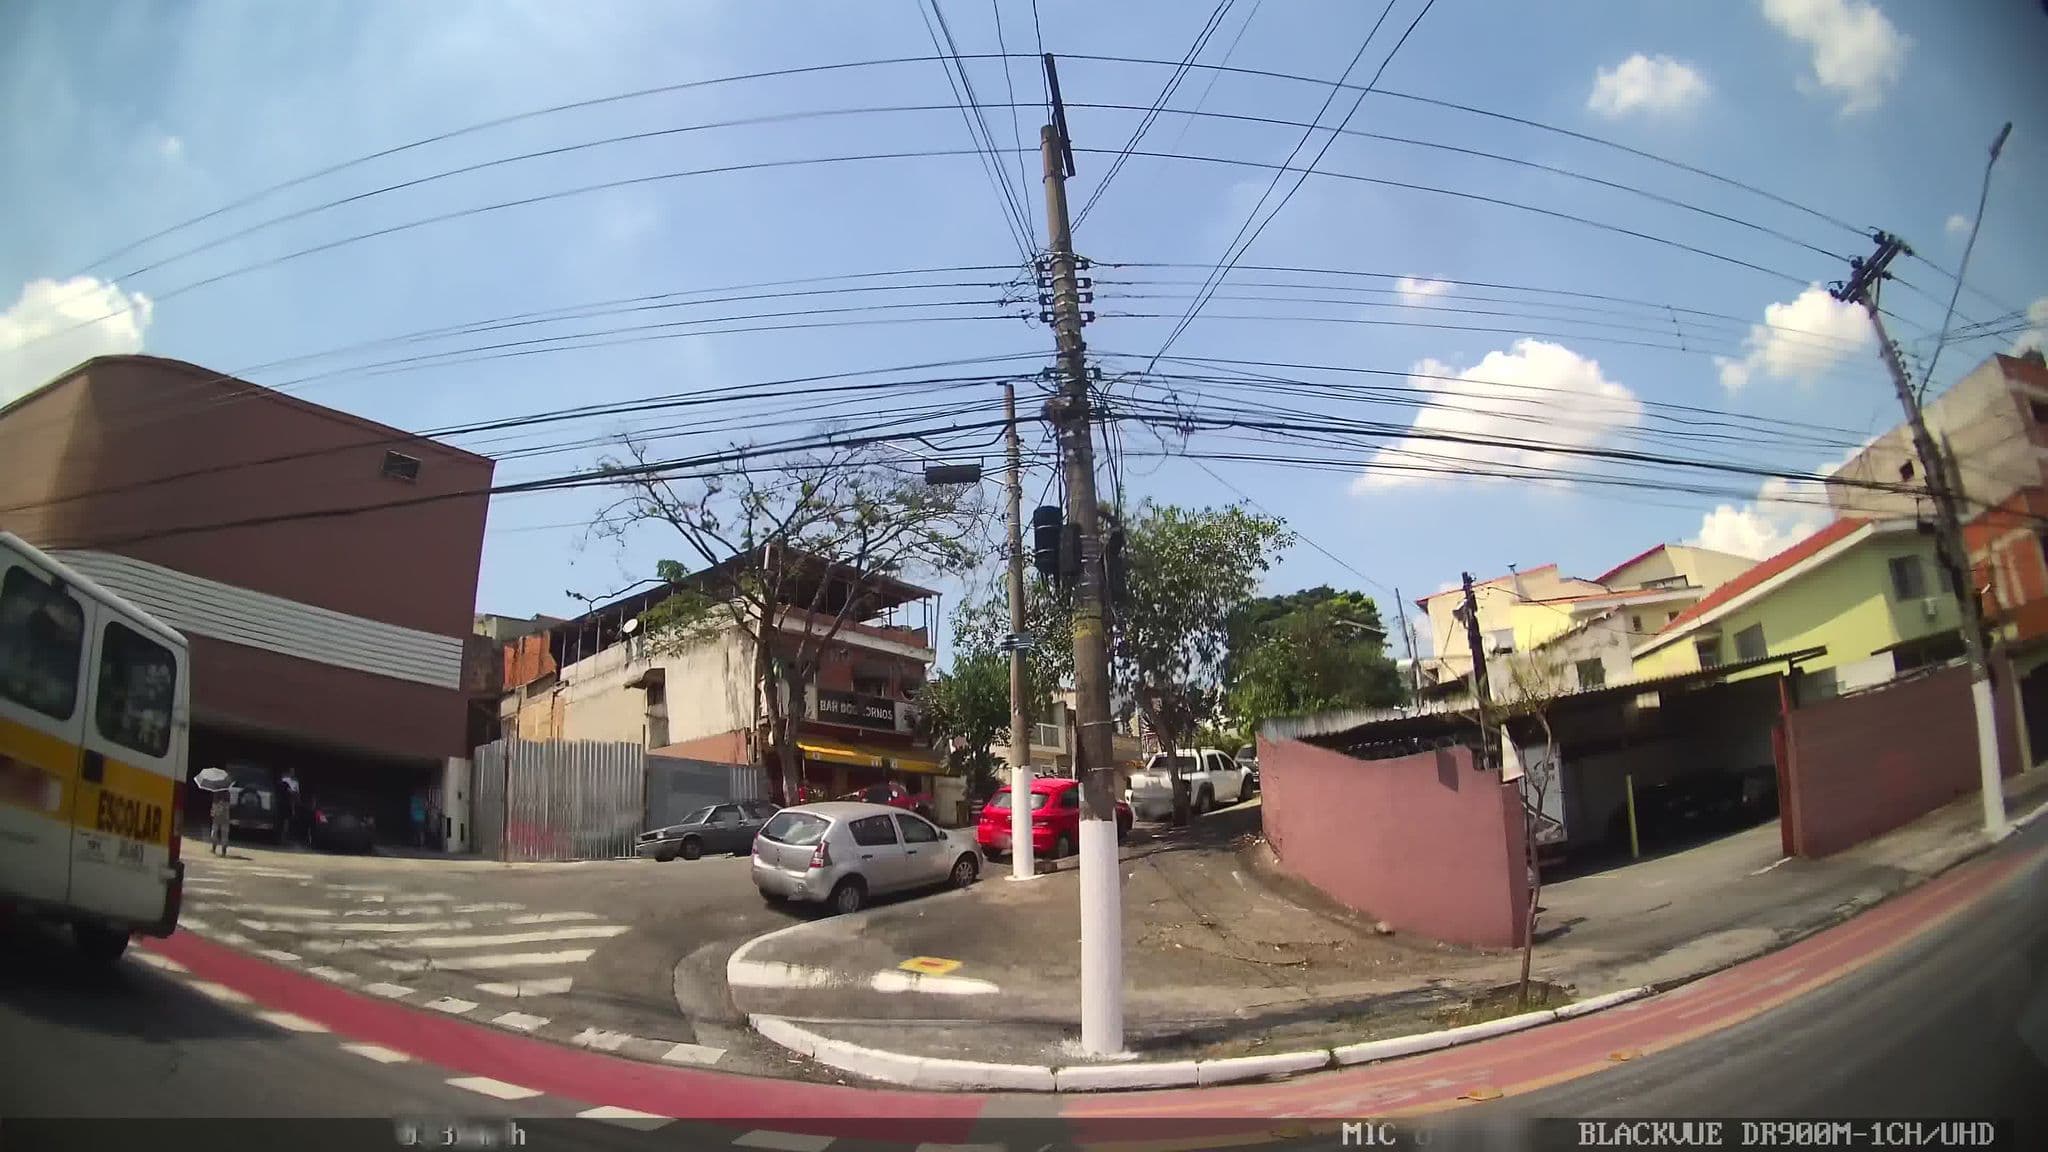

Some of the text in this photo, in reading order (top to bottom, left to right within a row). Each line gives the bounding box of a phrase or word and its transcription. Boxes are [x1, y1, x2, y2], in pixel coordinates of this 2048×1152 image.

[819, 699, 838, 713] BAR
[862, 706, 893, 720] ORNOS
[97, 788, 163, 842] ESCOLAR
